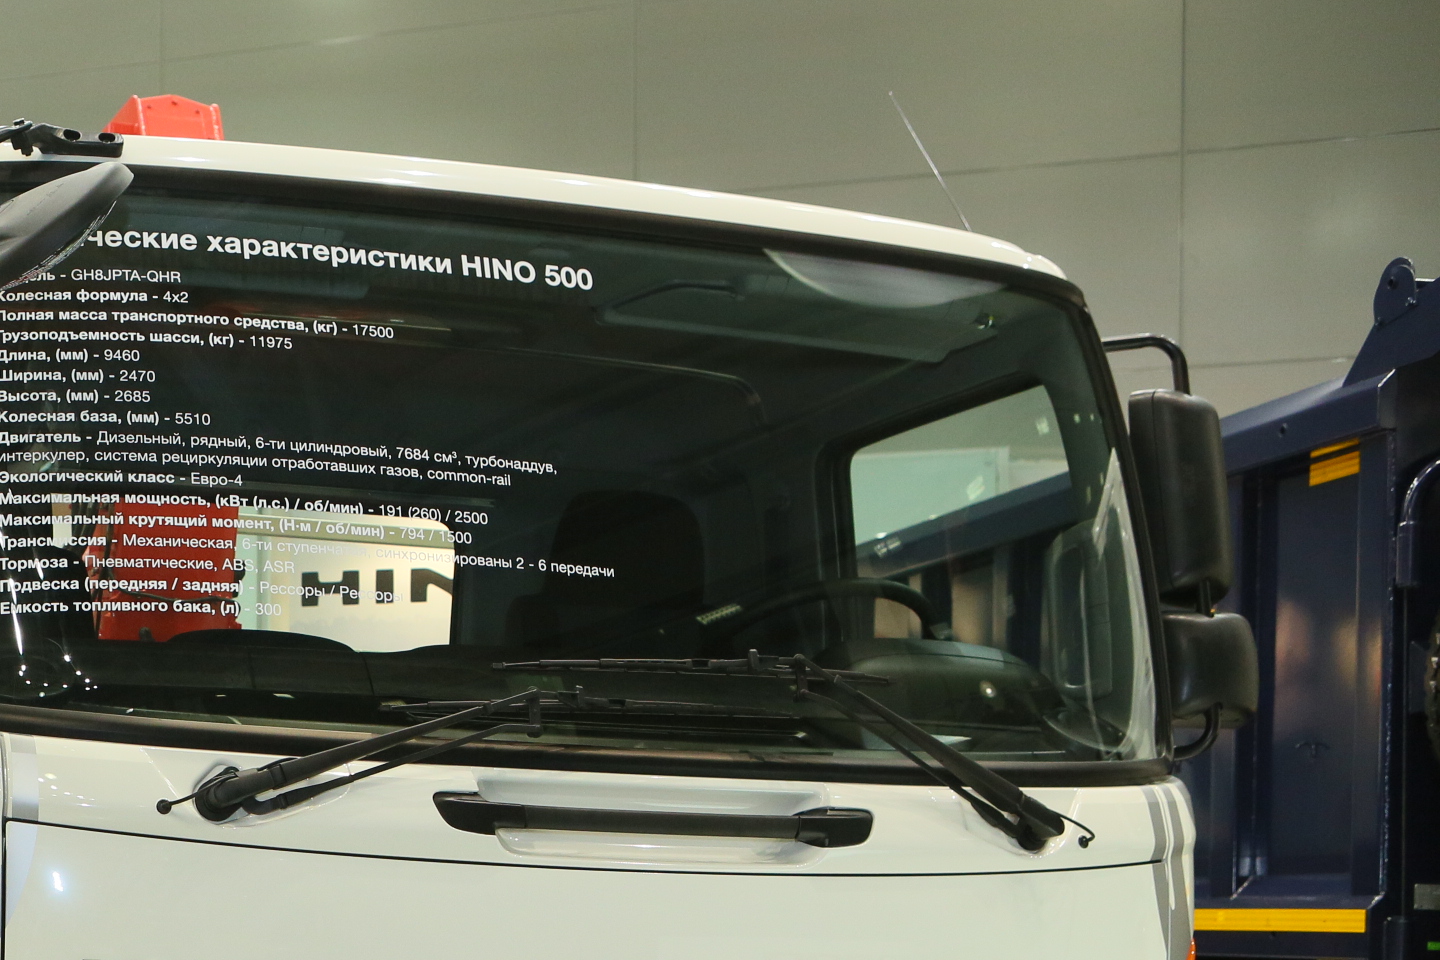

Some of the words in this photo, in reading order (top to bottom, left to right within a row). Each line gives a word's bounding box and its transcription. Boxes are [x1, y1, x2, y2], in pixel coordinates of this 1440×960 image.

[81, 229, 197, 250] ческие
[207, 233, 453, 275] характеристики
[461, 255, 536, 283] HINO
[544, 264, 593, 290] 500
[71, 270, 181, 282] GH8JPTA-QHR
[76, 288, 148, 303] формула
[59, 309, 107, 321] масса
[112, 312, 229, 325] транспортного
[234, 317, 309, 333] средства,
[313, 320, 337, 336] (кг)
[353, 324, 394, 339] 17500
[150, 332, 204, 345] шасси,
[209, 333, 234, 347] (кг)
[250, 336, 292, 349] 11975
[56, 349, 88, 363] (мм)
[104, 350, 139, 361] 9460
[71, 369, 104, 383] (мм)
[119, 370, 155, 382] 2470
[66, 390, 99, 403] (мм)
[114, 391, 150, 402] 2685
[80, 410, 122, 425] база,
[126, 411, 159, 425] (мм)
[175, 413, 210, 425] 5510
[97, 432, 186, 446] Дизельный,
[191, 435, 250, 450] рядный,
[255, 438, 285, 451] 6-ти
[290, 439, 392, 460] цилиндровый,
[396, 446, 429, 461] 7684
[465, 454, 557, 475] турбонаддув,
[94, 451, 157, 463] система
[162, 452, 267, 468] рециркуляции
[272, 456, 376, 474] отработавших
[380, 464, 423, 480] газов,
[428, 468, 510, 486] common-rail
[128, 472, 175, 483] класс
[191, 473, 242, 486] Евро-4
[125, 493, 210, 508] мощность,
[215, 494, 248, 508] (кВт
[253, 496, 288, 512] (л.с.)
[305, 500, 363, 515] об/мин)
[379, 505, 401, 518] 191
[408, 507, 441, 522] (260)
[455, 511, 488, 524] 2500
[129, 513, 207, 529] крутящий
[212, 517, 274, 531] момент,
[326, 522, 385, 539] об/мин)
[400, 528, 425, 539] 794
[440, 531, 472, 544] 1500
[0, 535, 106, 548] Трансмиссия
[123, 535, 236, 552] Механическая,
[242, 539, 272, 550] 6-ти
[376, 548, 512, 568] синхронизированы
[516, 558, 524, 569] 2
[538, 560, 546, 571] 6
[551, 563, 614, 578] передачи
[0, 558, 68, 570] Тормоза
[85, 556, 217, 571] Пневматические,
[264, 561, 294, 573] ASR
[0, 579, 79, 593] Подвеска
[84, 579, 167, 592] (передняя
[182, 580, 243, 594] задняя)
[260, 583, 325, 598] Рессоры
[0, 601, 68, 614] Емкость
[73, 600, 168, 613] топливного
[173, 601, 215, 615] бака,
[221, 602, 240, 617] (л)
[256, 604, 281, 615] 300
